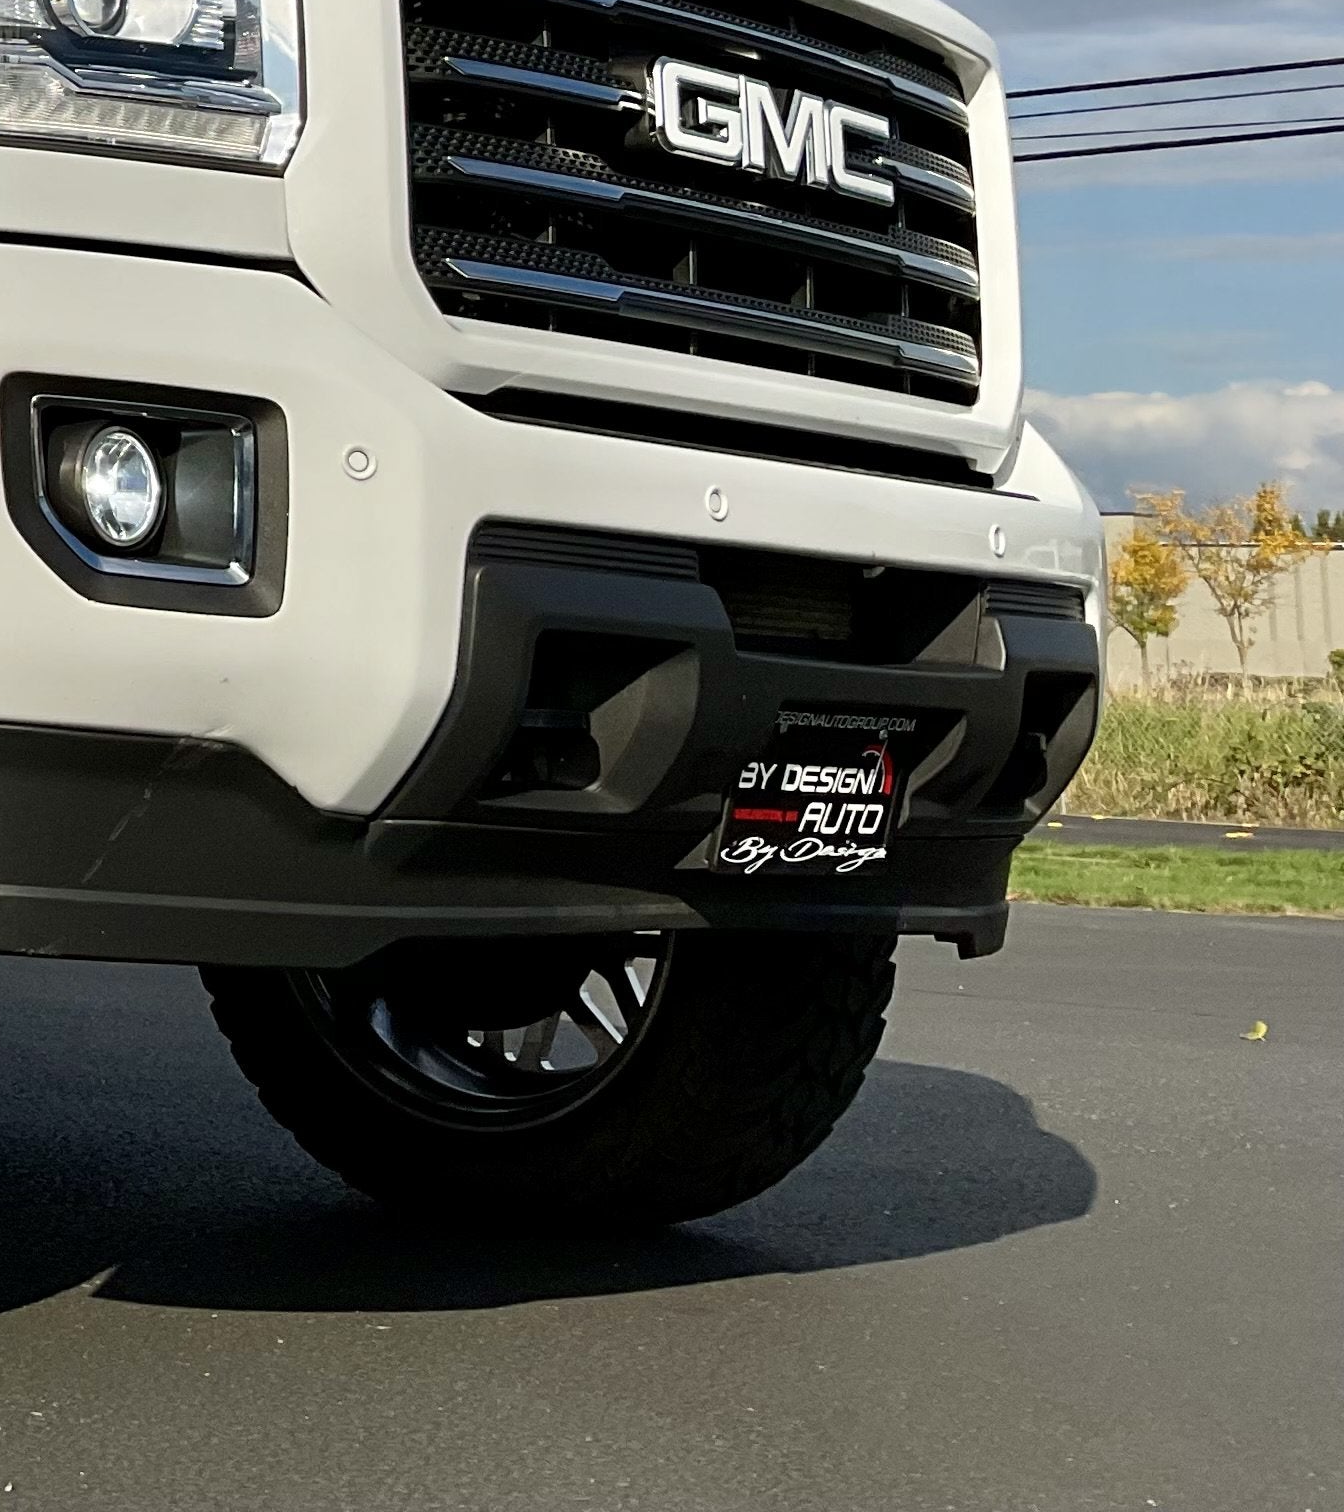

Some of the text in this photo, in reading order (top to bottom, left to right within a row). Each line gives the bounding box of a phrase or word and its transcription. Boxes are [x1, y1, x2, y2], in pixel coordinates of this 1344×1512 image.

[652, 56, 894, 207] GMC
[738, 762, 878, 794] BY DESIGN
[798, 802, 884, 835] AUTO
[720, 837, 887, 874] By Design
